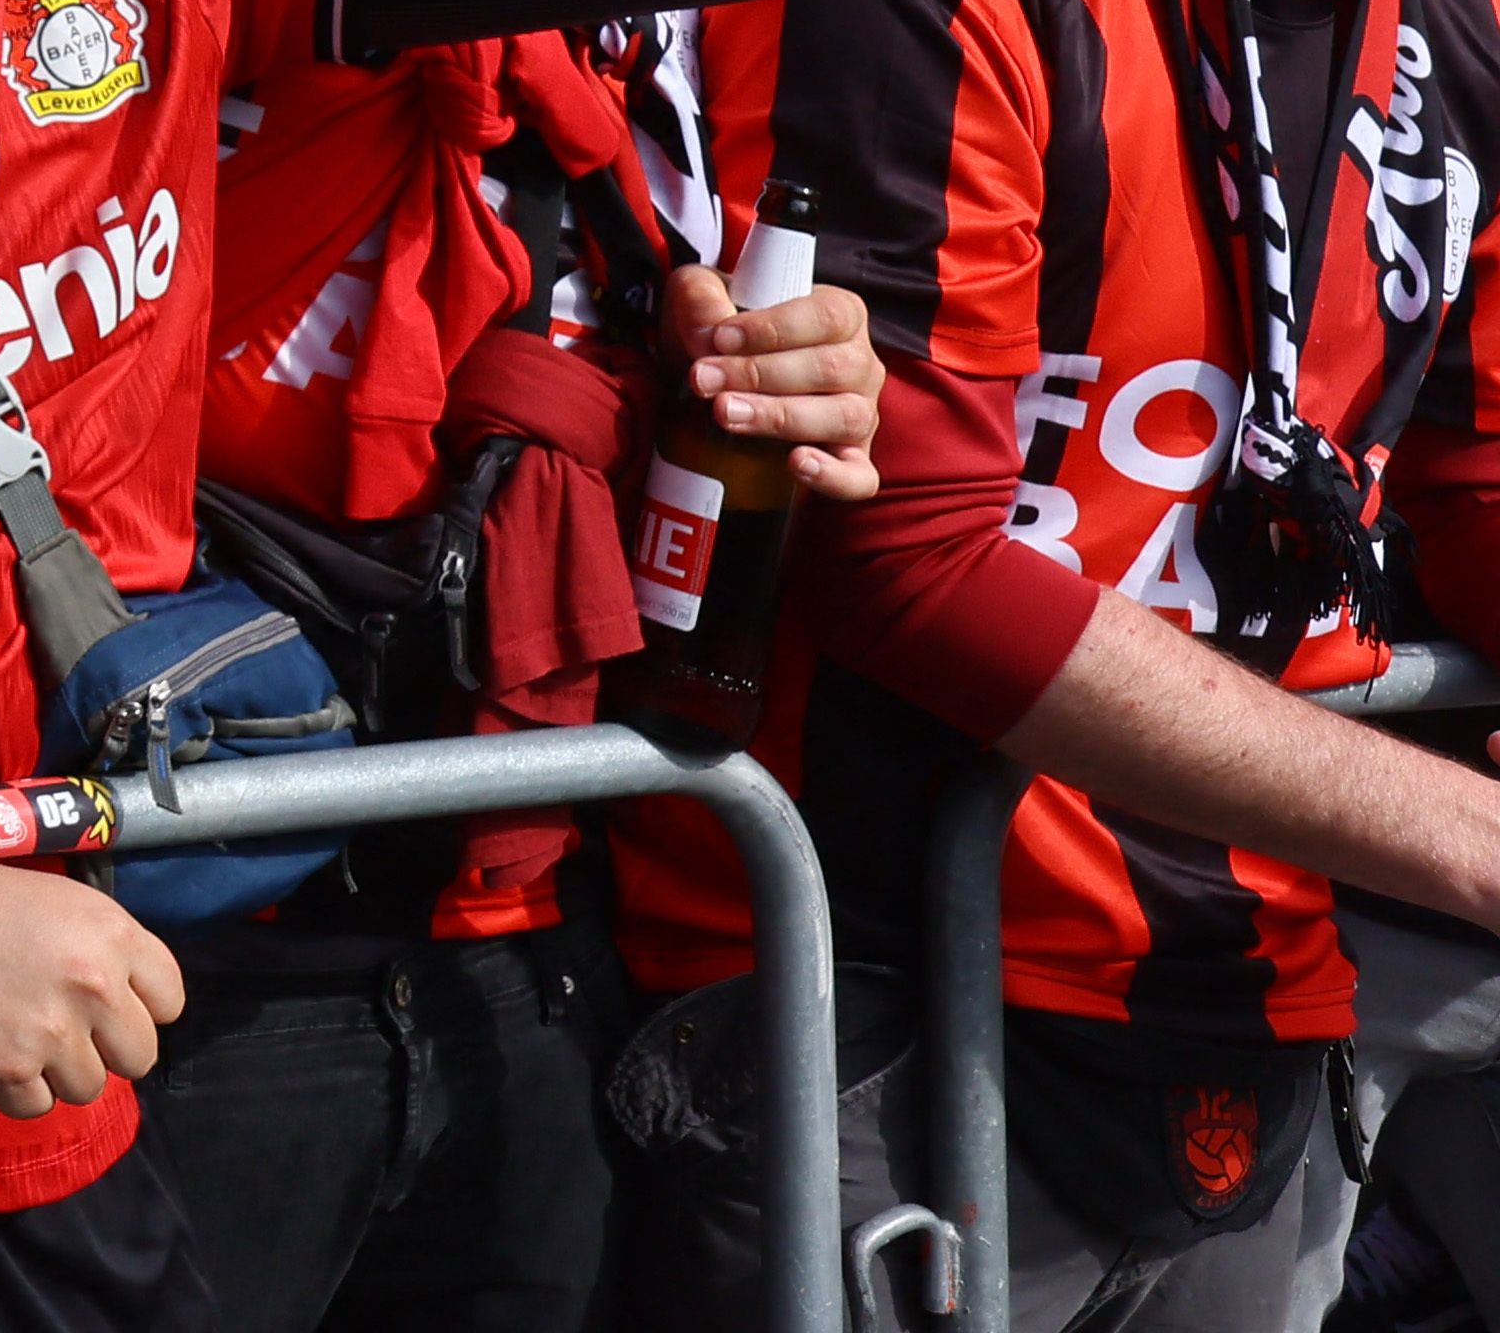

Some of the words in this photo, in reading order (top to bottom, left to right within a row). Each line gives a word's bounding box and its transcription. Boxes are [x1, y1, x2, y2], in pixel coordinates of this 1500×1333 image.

[45, 31, 102, 63] BAYER
[37, 69, 136, 114] Leverkusen
[36, 790, 83, 830] 20
